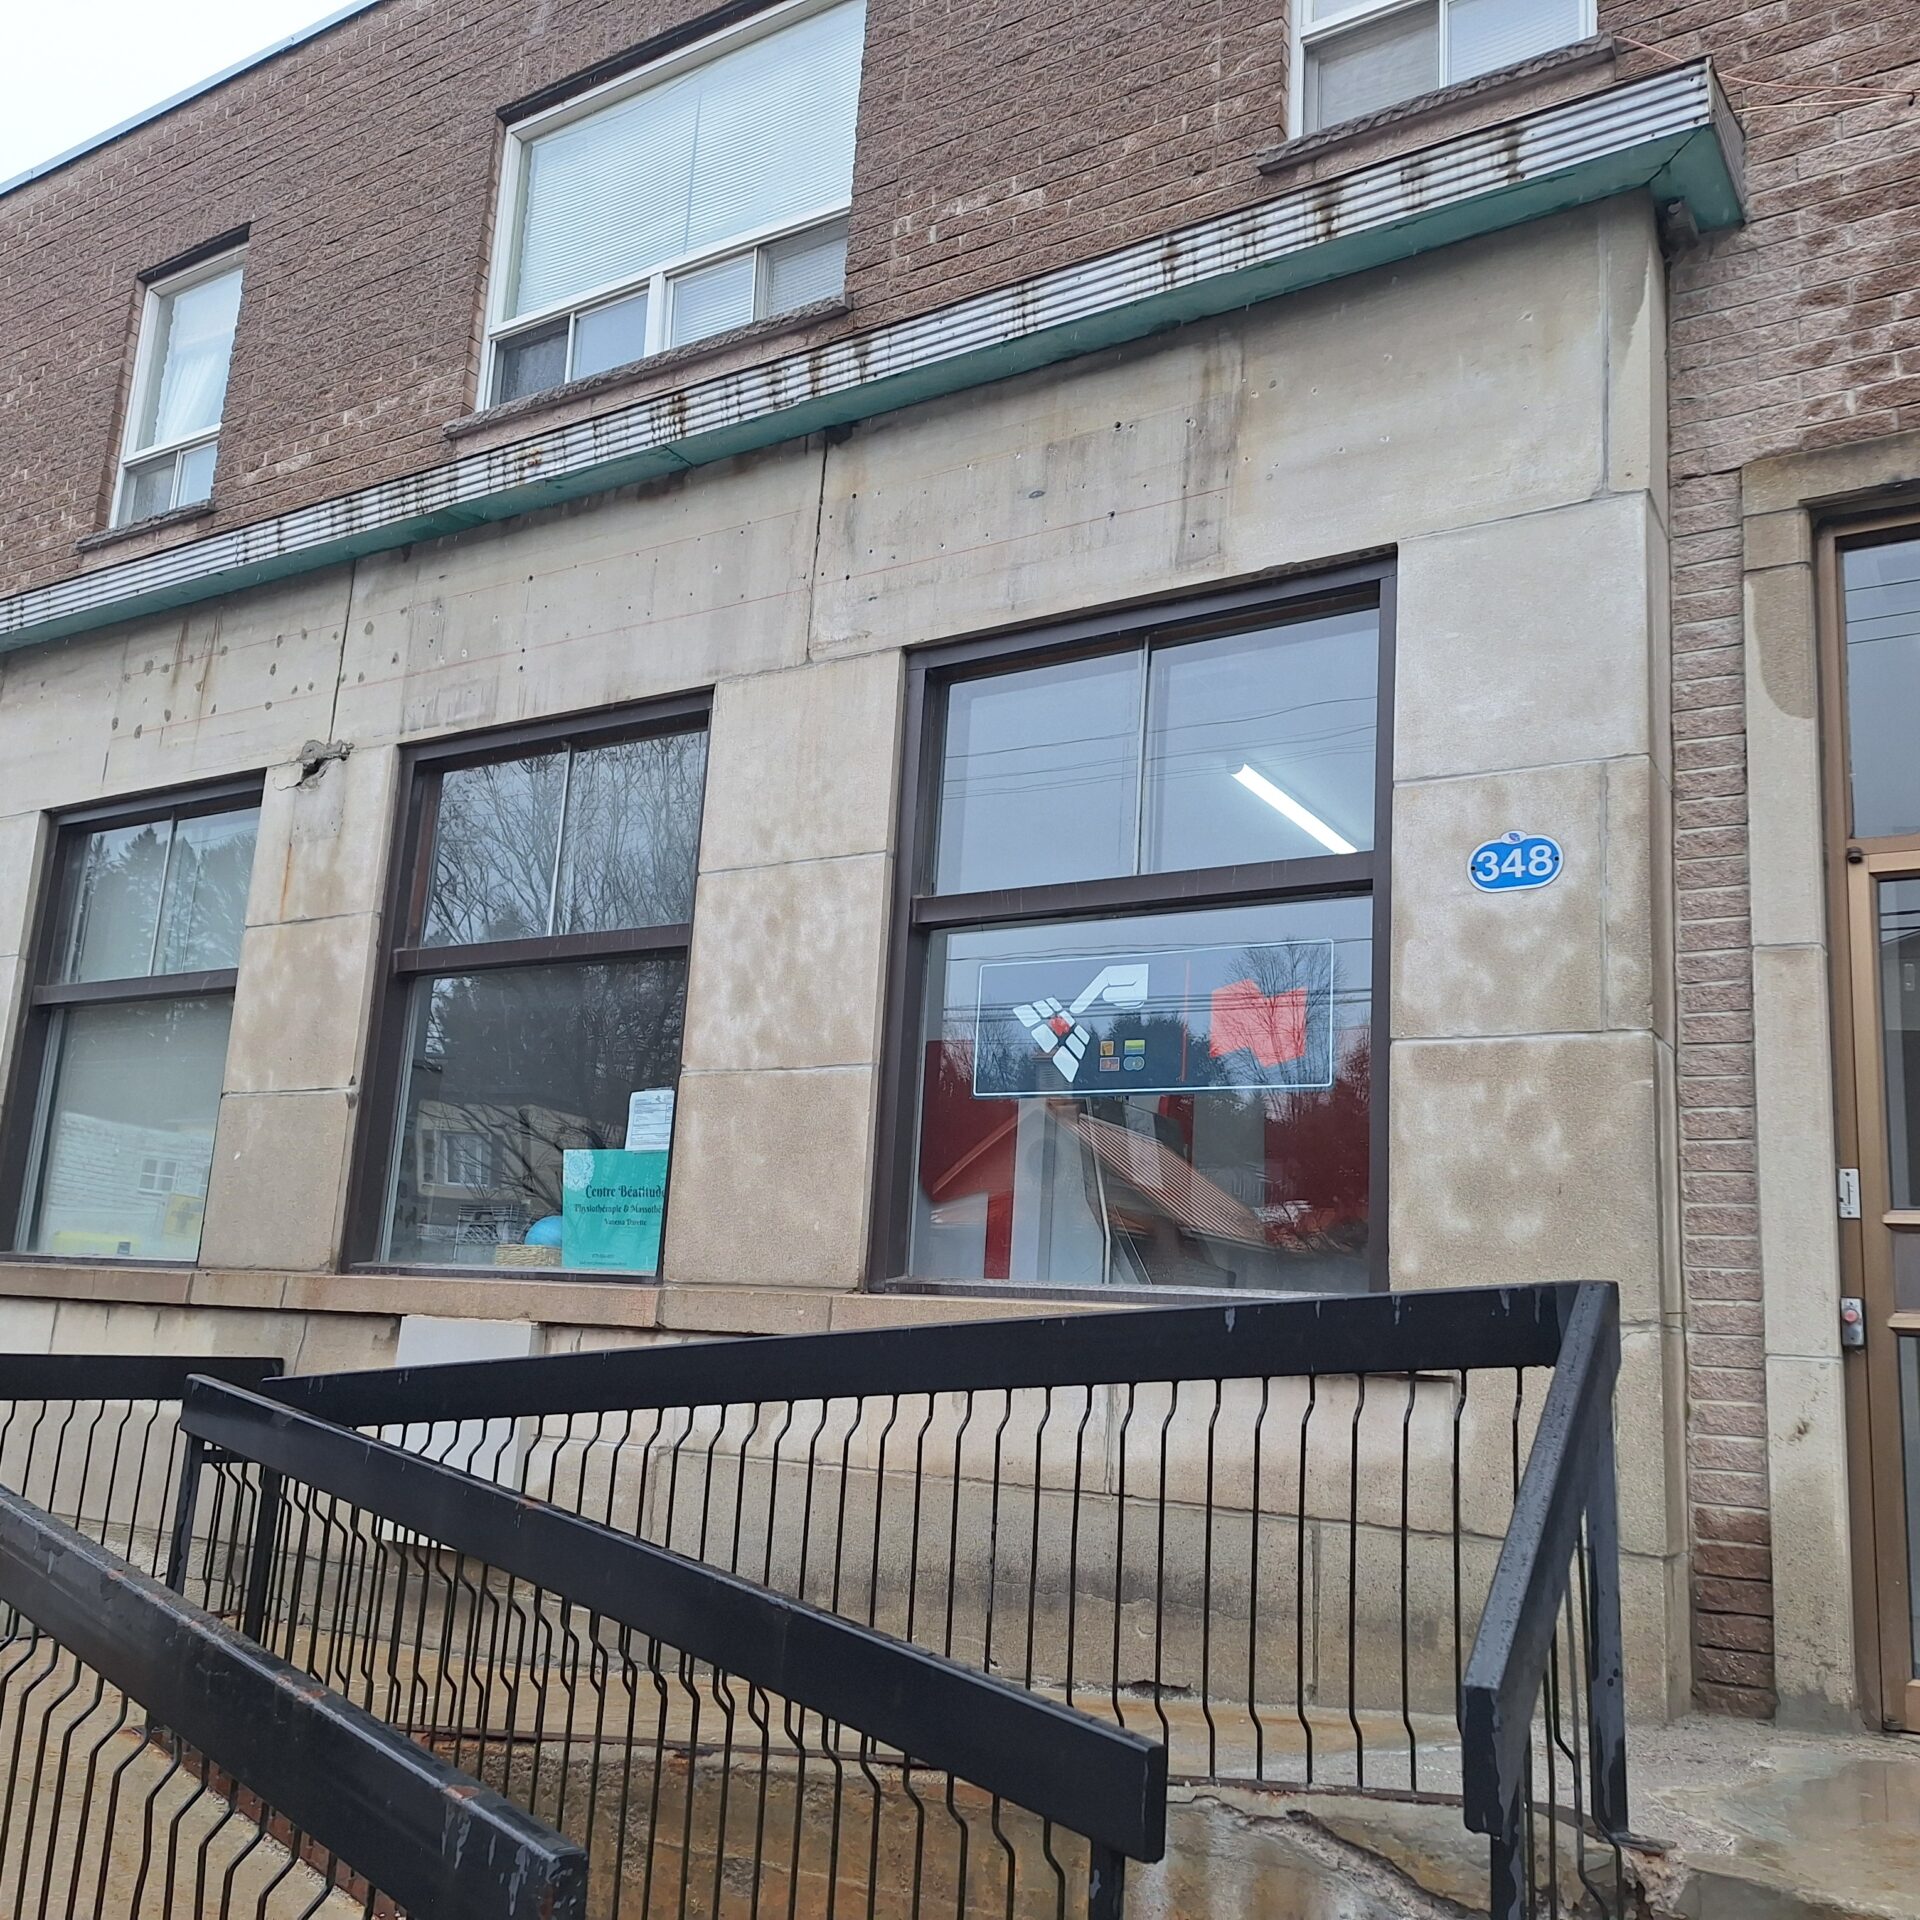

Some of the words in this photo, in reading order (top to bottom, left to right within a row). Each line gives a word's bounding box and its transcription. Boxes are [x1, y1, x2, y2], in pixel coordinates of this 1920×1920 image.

[1476, 844, 1553, 882] 348
[586, 1184, 616, 1199] Centre
[623, 1204, 629, 1213] &
